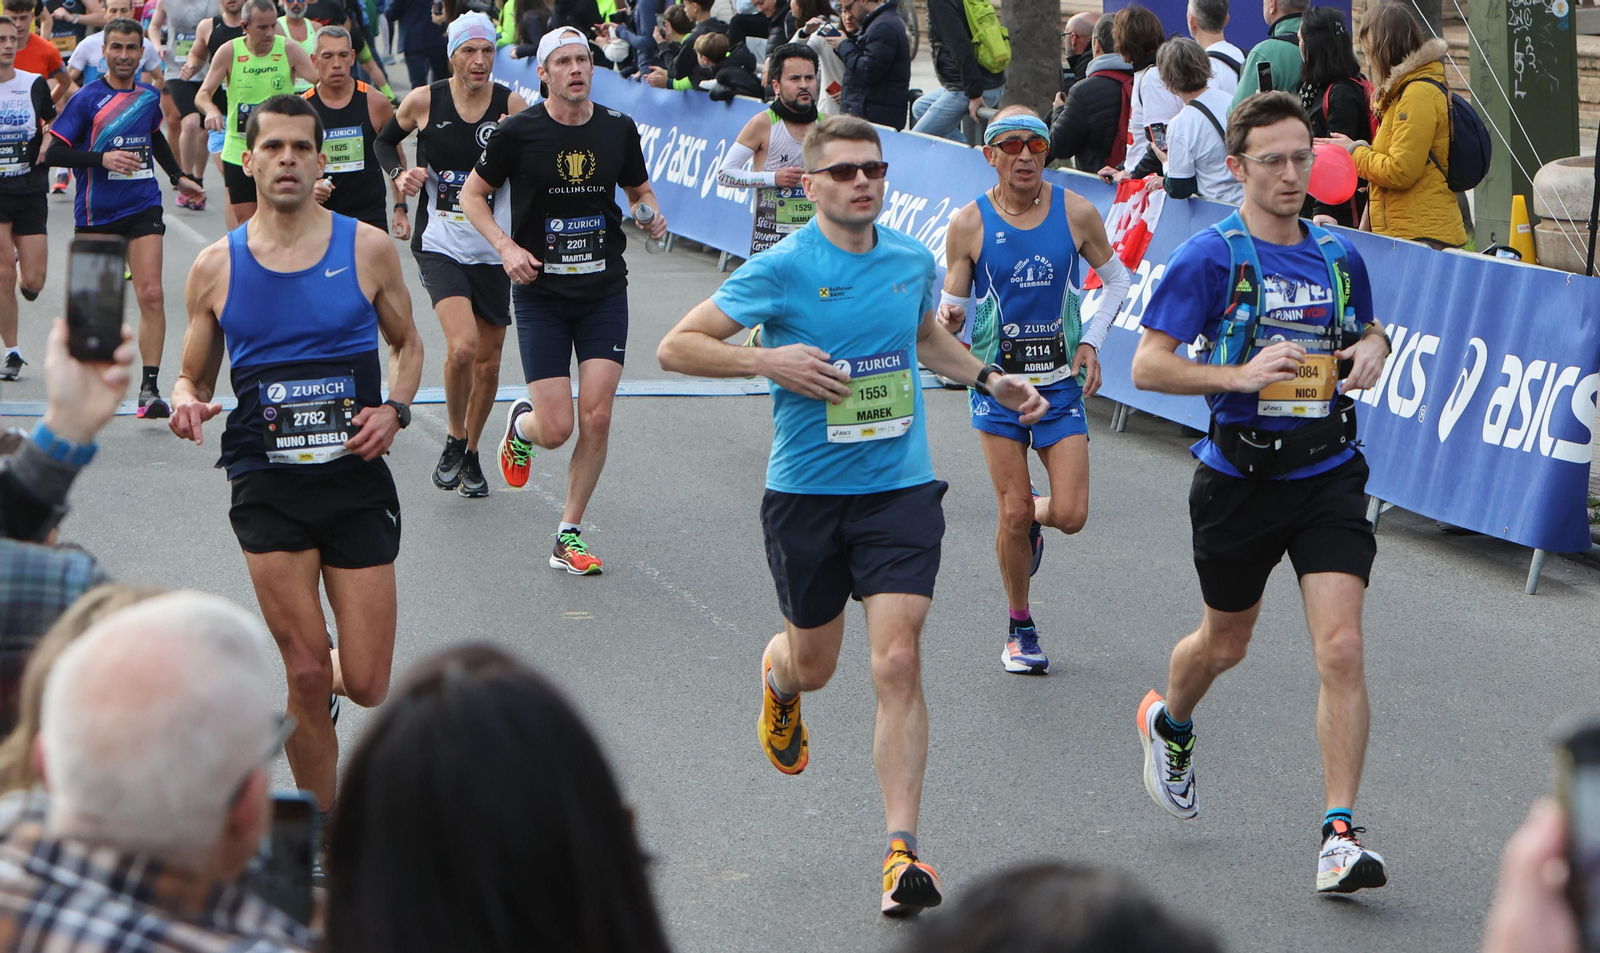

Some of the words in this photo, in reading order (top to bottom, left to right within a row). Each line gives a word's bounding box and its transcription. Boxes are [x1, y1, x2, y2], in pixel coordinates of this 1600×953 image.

[242, 66, 277, 75] Laguna
[329, 128, 357, 137] ZURICH
[666, 133, 707, 188] asics
[548, 186, 585, 194] COLLINS
[794, 203, 812, 212] 1529
[567, 218, 600, 230] ZURICH
[566, 238, 586, 249] 2201
[561, 252, 592, 262] MARTIJN
[1034, 254, 1053, 279] ORIPPO
[1024, 319, 1060, 333] ZURICH
[1025, 344, 1051, 356] 2114
[856, 354, 900, 372] ZURICH
[1024, 361, 1054, 371] ADRIAN
[292, 382, 344, 396] ZURICH
[858, 384, 887, 400] 1553
[1295, 387, 1317, 398] NICO
[856, 406, 892, 421] MAREK
[1482, 353, 1600, 464] asics
[293, 410, 326, 426] 2782
[276, 435, 305, 448] NUNO
[307, 431, 348, 445] REBELO
